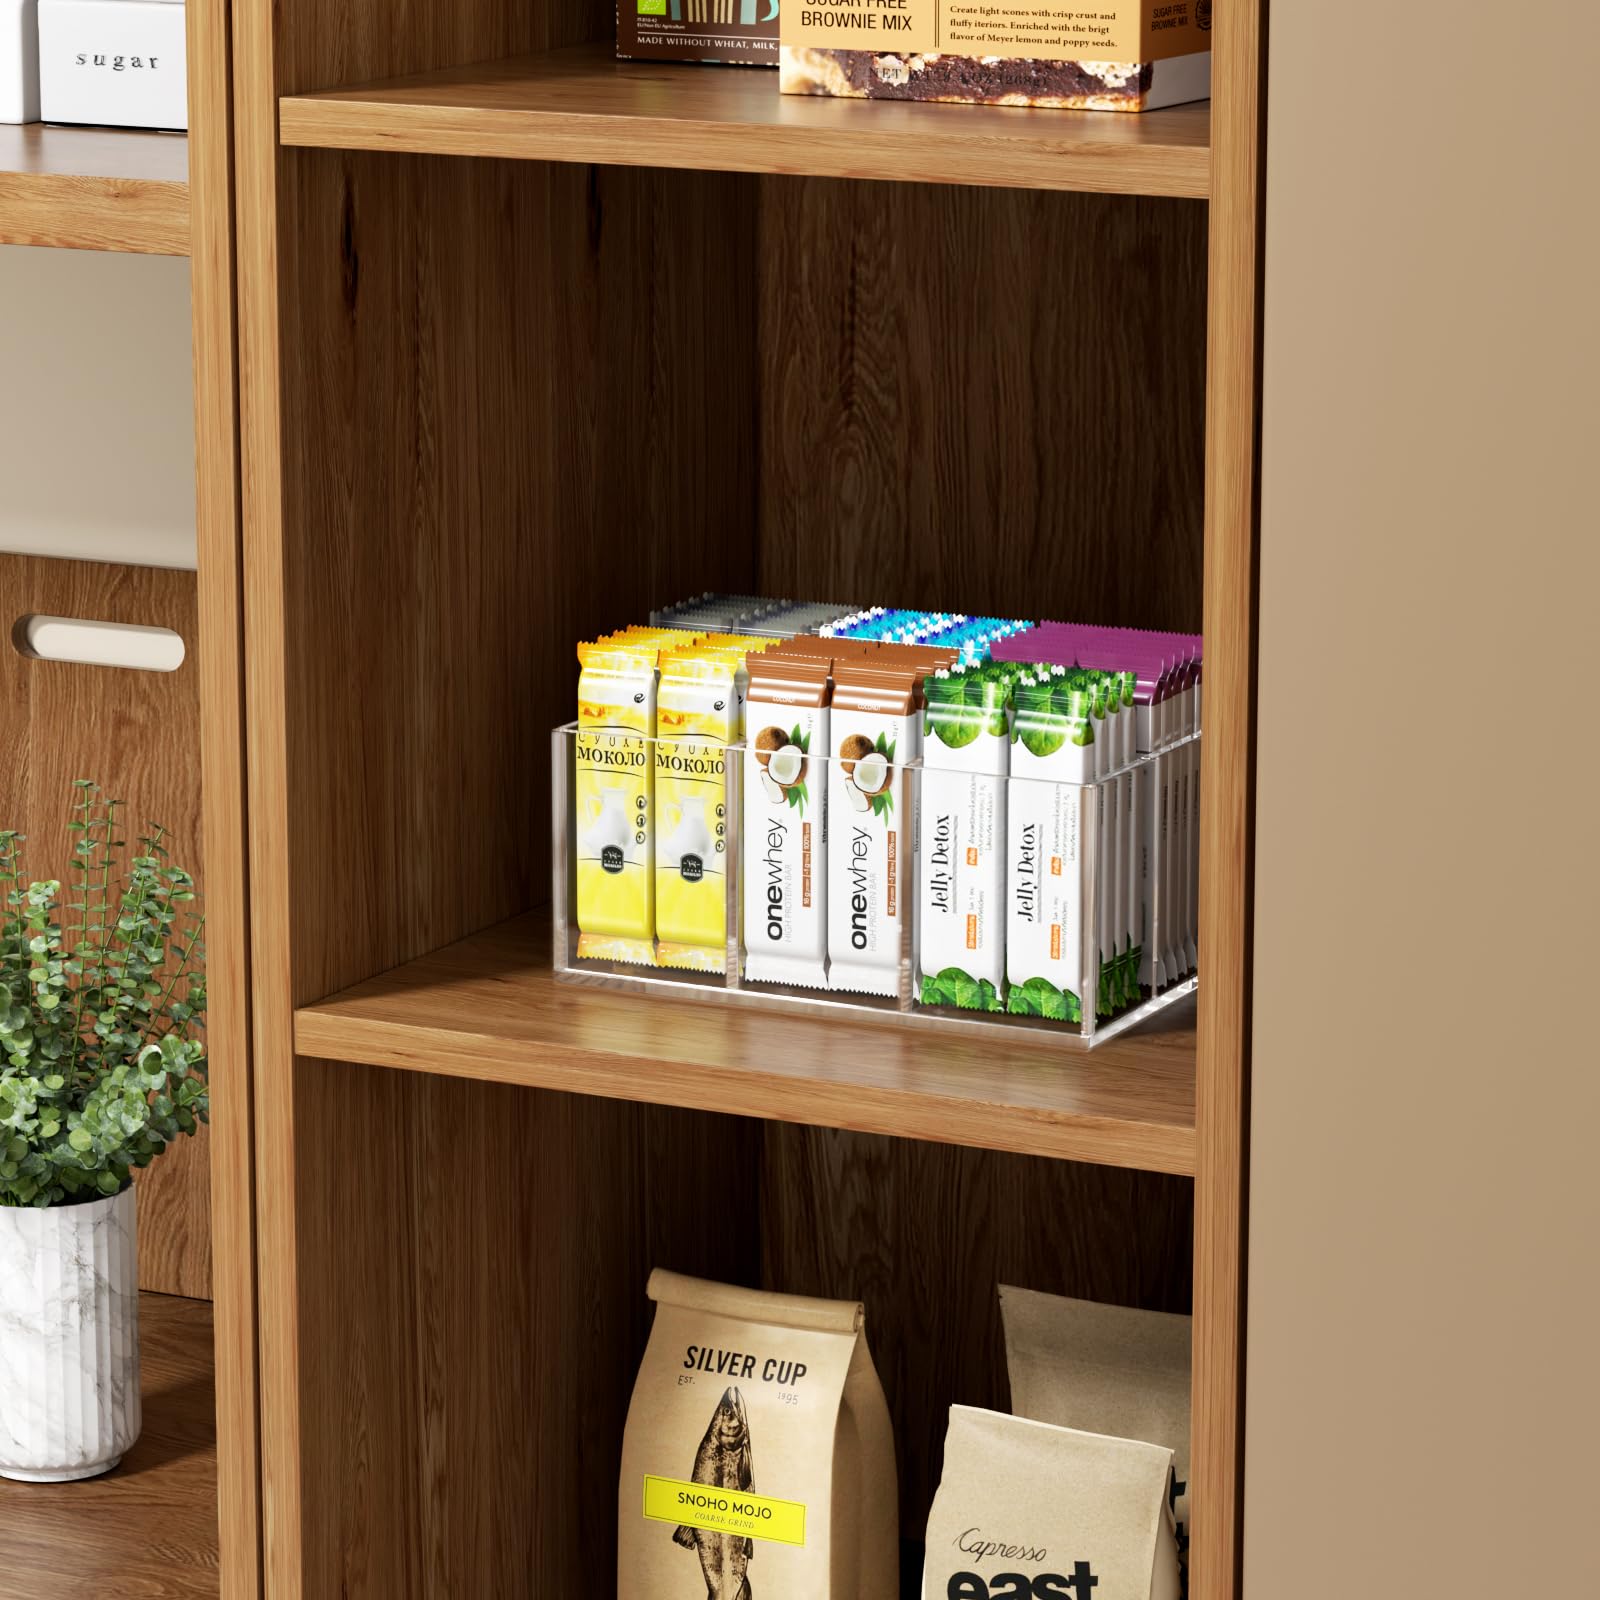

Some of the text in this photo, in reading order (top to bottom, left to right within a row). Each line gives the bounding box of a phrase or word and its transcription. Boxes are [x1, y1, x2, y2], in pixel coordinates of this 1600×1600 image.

[801, 11, 912, 31] BROWNIE MIX
[950, 6, 977, 14] Create
[980, 6, 999, 16] light
[1031, 9, 1050, 17] with
[1053, 11, 1073, 20] crisp
[1100, 12, 1116, 20] and
[950, 19, 1109, 34] fluffy iteriors. Enriched with the brigt
[637, 36, 778, 51] MADE WITHOUT WHEAT, MILK,
[950, 32, 1118, 48] flavor of Meyer lemon and poppy seeds.
[75, 52, 160, 71] sugar
[577, 746, 646, 766] МОКОЛО
[656, 754, 725, 774] МОКОЛО
[930, 815, 952, 913] Jelly Detox
[1017, 823, 1038, 922] Jelly Detox
[762, 818, 788, 940] onewhey
[848, 826, 872, 950] onewhey
[784, 864, 792, 943] HIGH PROTEIN BAR
[684, 1346, 807, 1386] SILVER CUP
[678, 1375, 696, 1386] EST.
[777, 1392, 799, 1406] 1995
[678, 1492, 772, 1520] SNOHO MOJO
[694, 1512, 754, 1529] COARSE GRIND
[952, 1528, 1046, 1562] Capresso
[947, 1561, 1099, 1600] east
